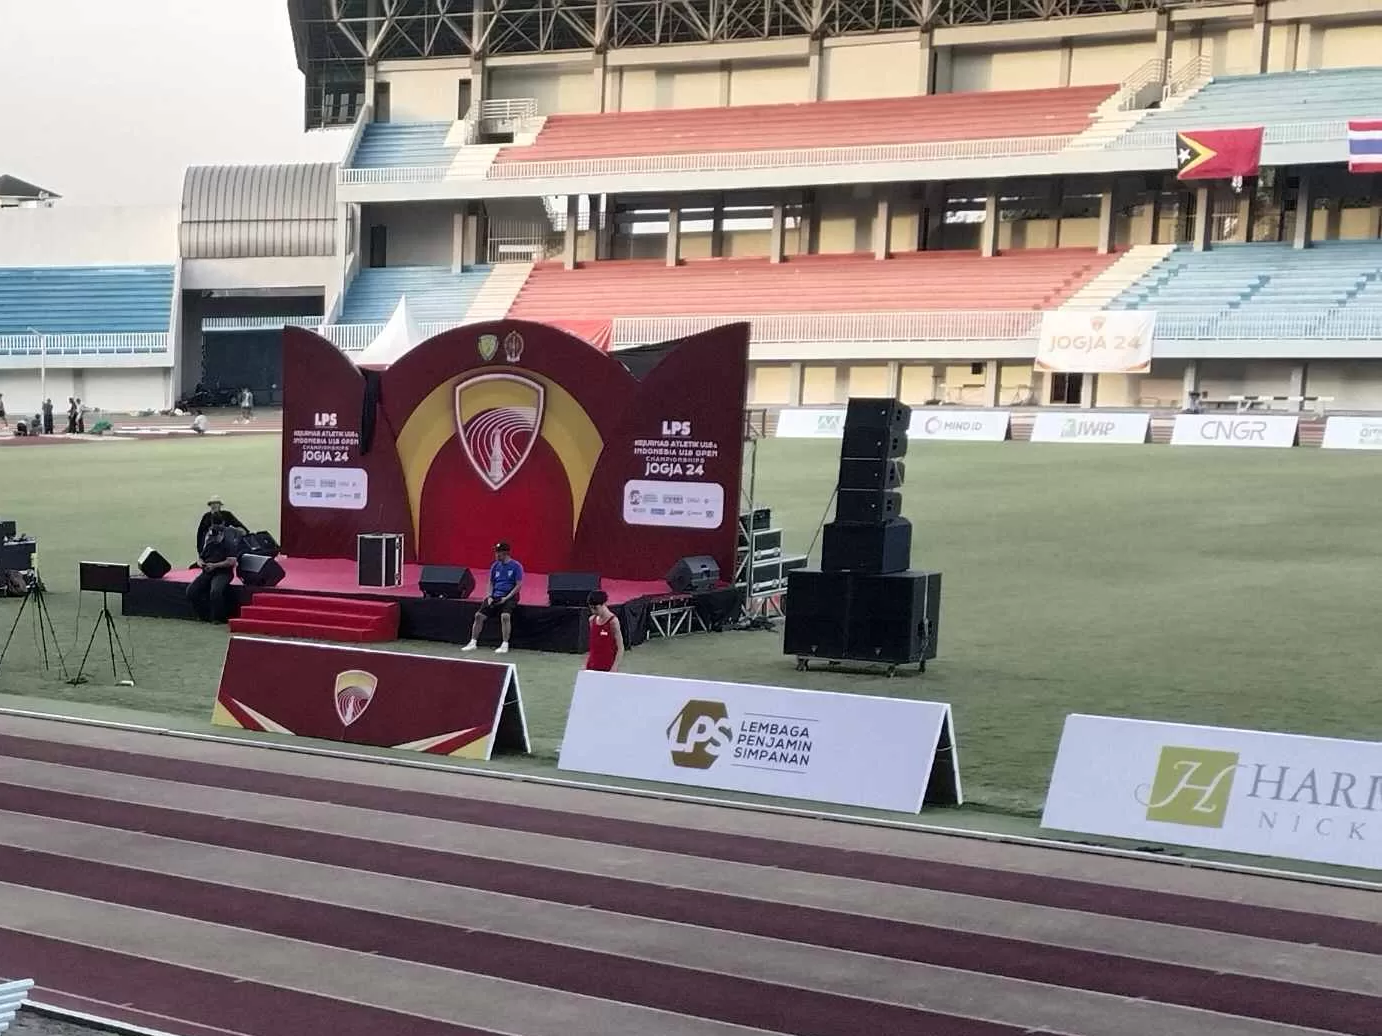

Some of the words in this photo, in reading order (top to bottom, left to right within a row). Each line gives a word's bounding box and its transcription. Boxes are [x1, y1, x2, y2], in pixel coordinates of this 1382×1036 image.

[1048, 335, 1107, 353] JOGJA
[1113, 335, 1143, 350] 24
[314, 412, 338, 427] LPS
[662, 420, 691, 436] LPS
[1077, 418, 1116, 437] IWIP
[1200, 420, 1267, 441] CNGR
[634, 447, 677, 455] INDONESIA
[695, 449, 718, 457] OPEN
[670, 440, 699, 448] ATLETIK
[302, 451, 332, 463] JOGJA
[334, 451, 349, 462] 24
[645, 456, 706, 464] CHAMPIONSHIPS
[645, 462, 683, 477] JOGJA
[685, 464, 705, 476] 24
[668, 713, 732, 757] LPS
[740, 720, 811, 739] LEMBAGA
[737, 734, 813, 753] PENJAMIN
[734, 746, 811, 766] SIMPANAN
